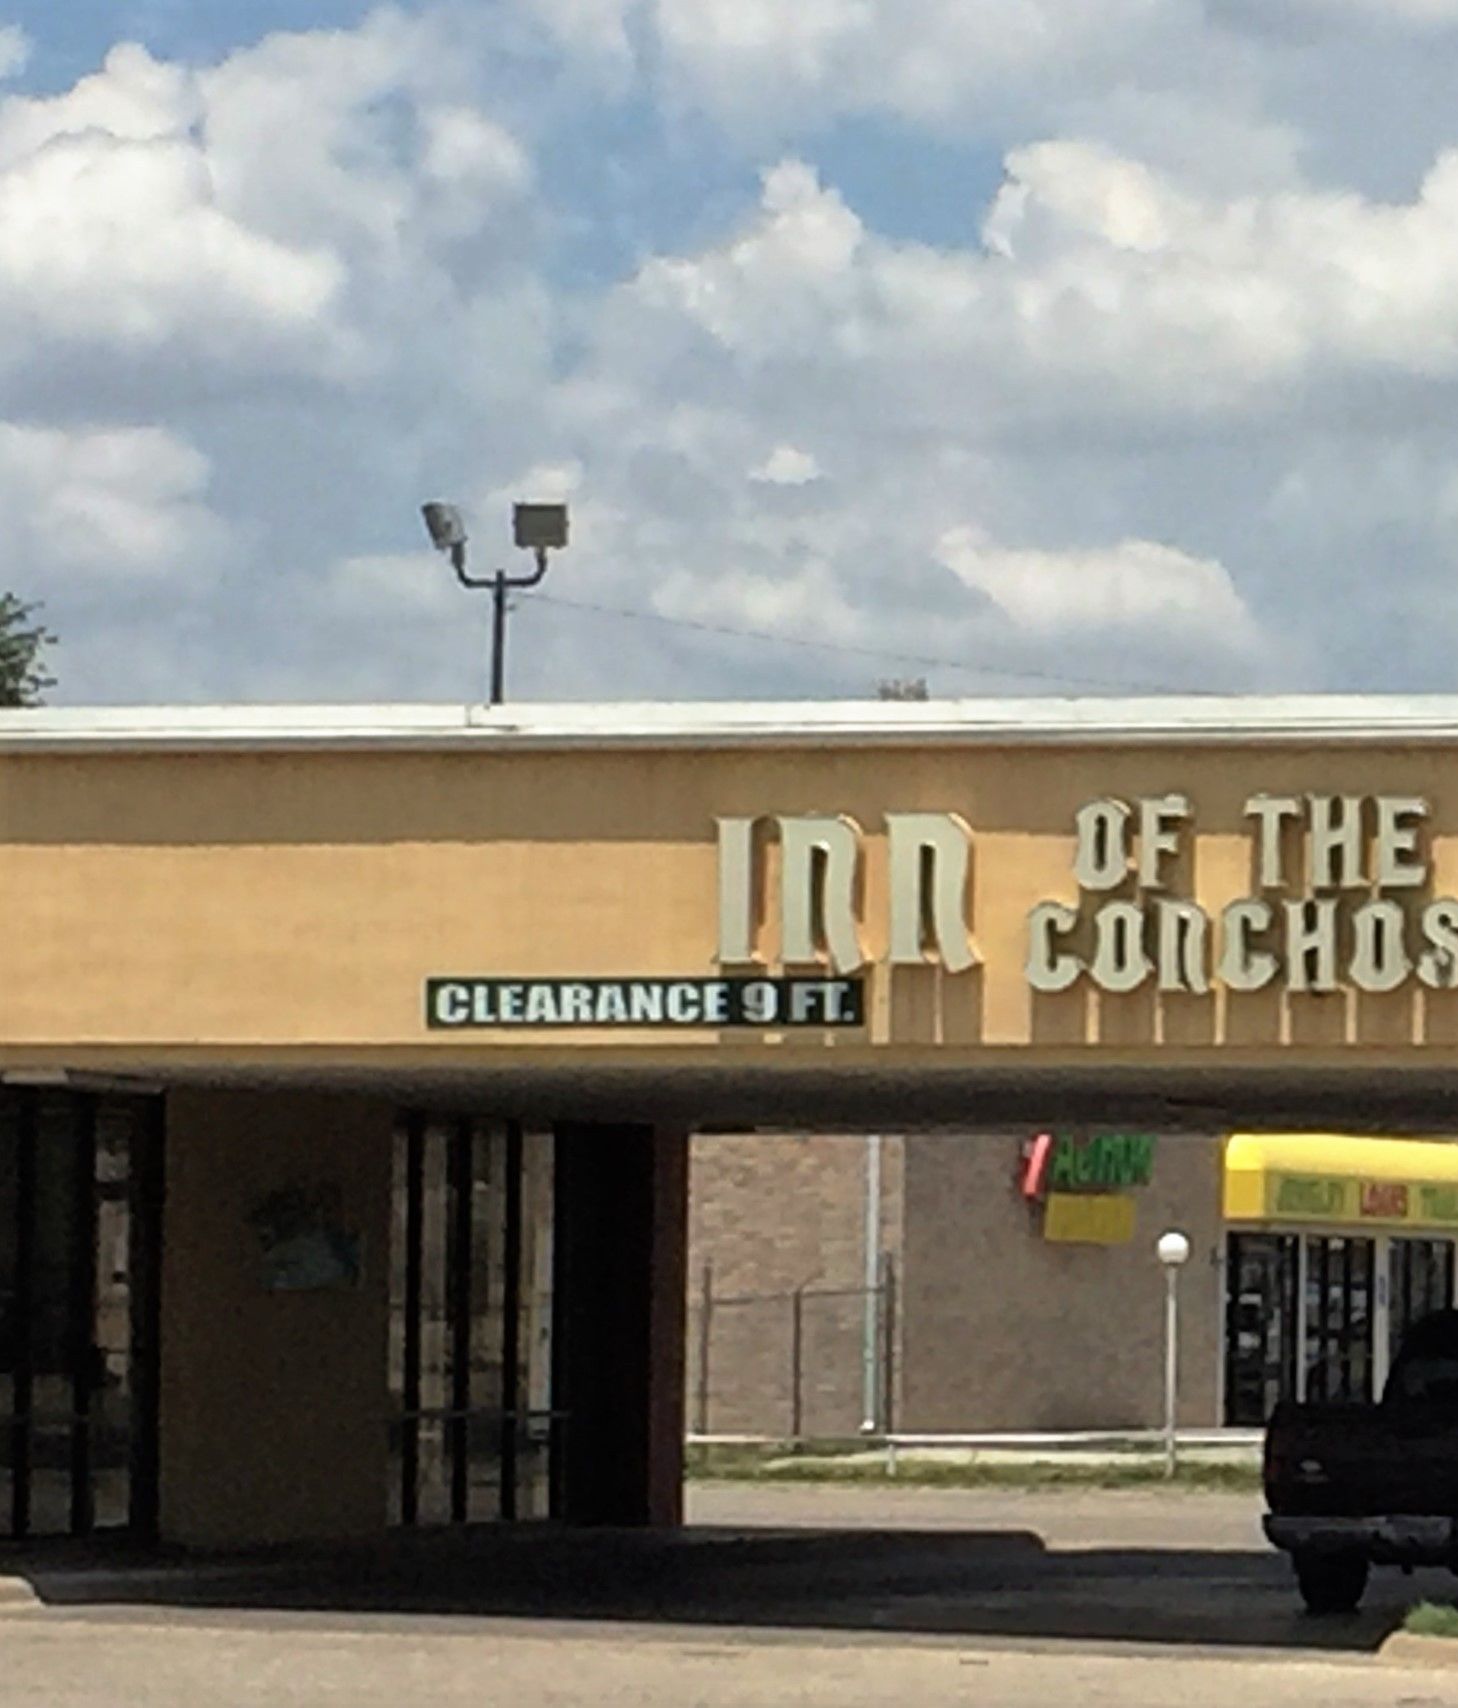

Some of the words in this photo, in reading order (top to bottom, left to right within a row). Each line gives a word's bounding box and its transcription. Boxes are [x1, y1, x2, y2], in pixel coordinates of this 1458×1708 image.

[1074, 797, 1191, 890] OF
[1245, 794, 1430, 888] THE
[714, 810, 985, 974] INN
[435, 982, 729, 1023] CLEARANCE
[741, 981, 778, 1022] 9
[790, 981, 856, 1022] FT.
